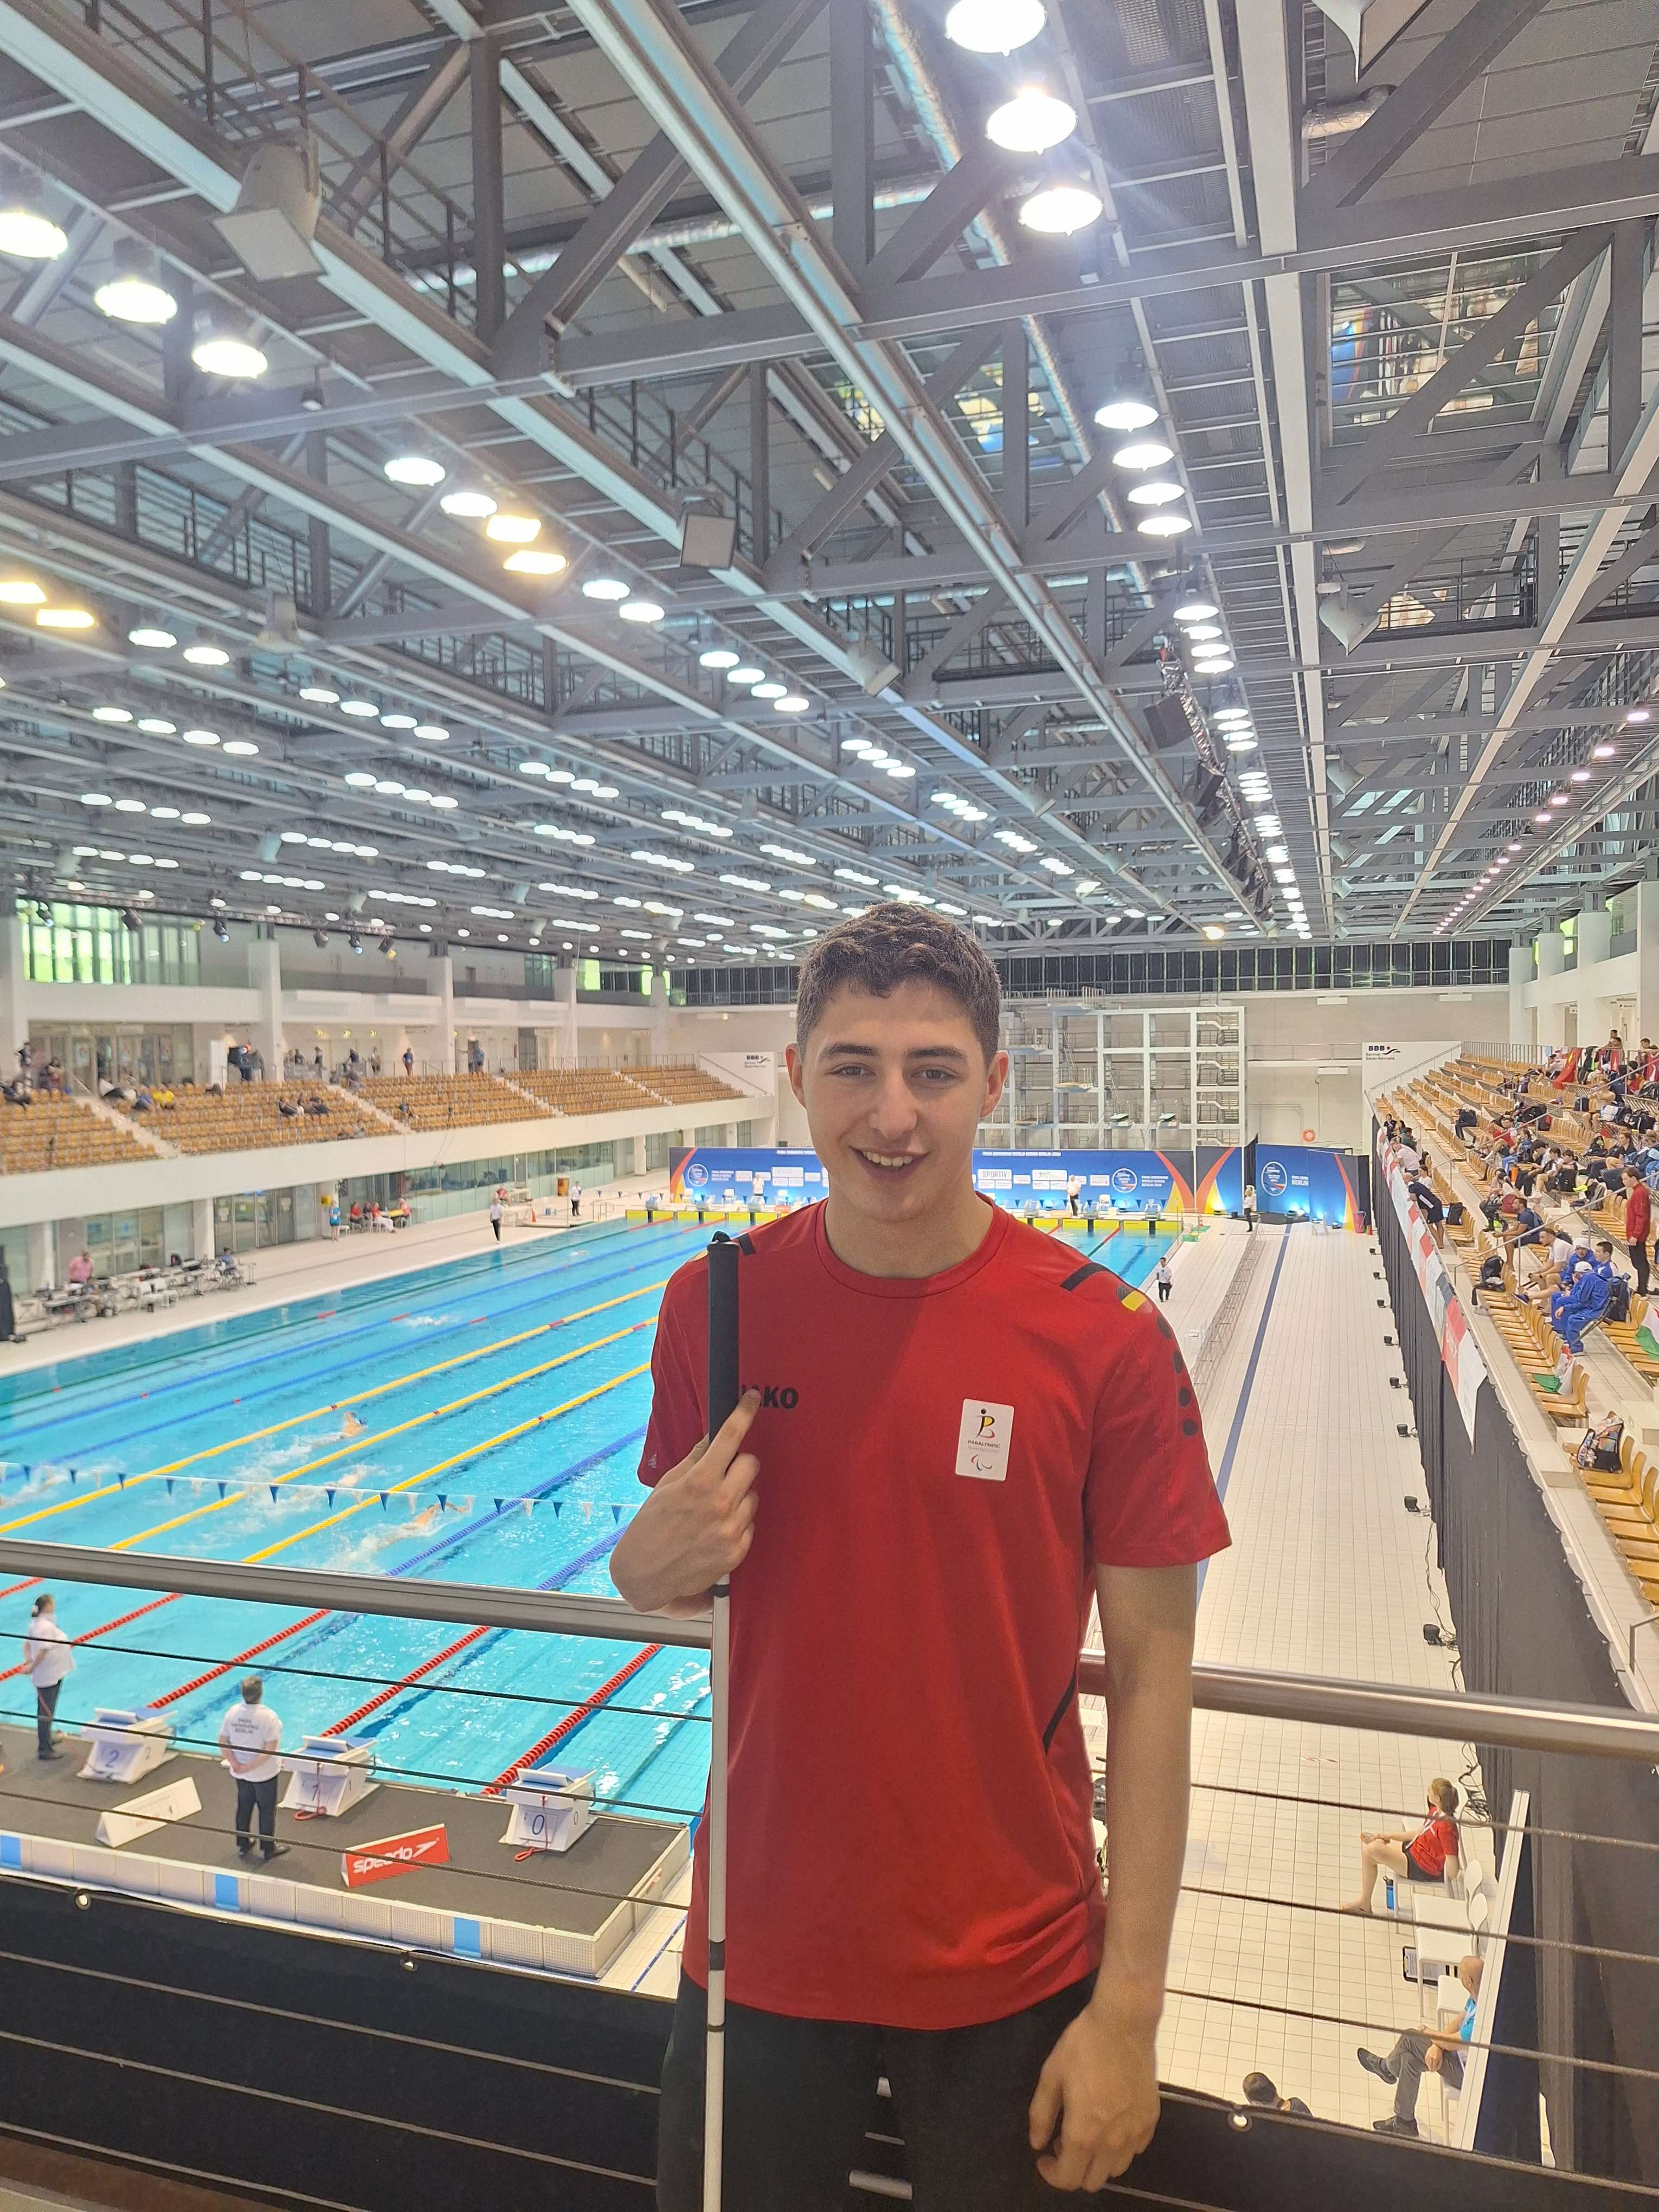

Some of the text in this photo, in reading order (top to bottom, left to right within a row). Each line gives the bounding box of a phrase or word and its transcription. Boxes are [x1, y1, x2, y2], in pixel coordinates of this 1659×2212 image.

[968, 1439, 1000, 1448] PARALYMPIC
[105, 1750, 120, 1768] 2
[532, 1814, 545, 1835] 0
